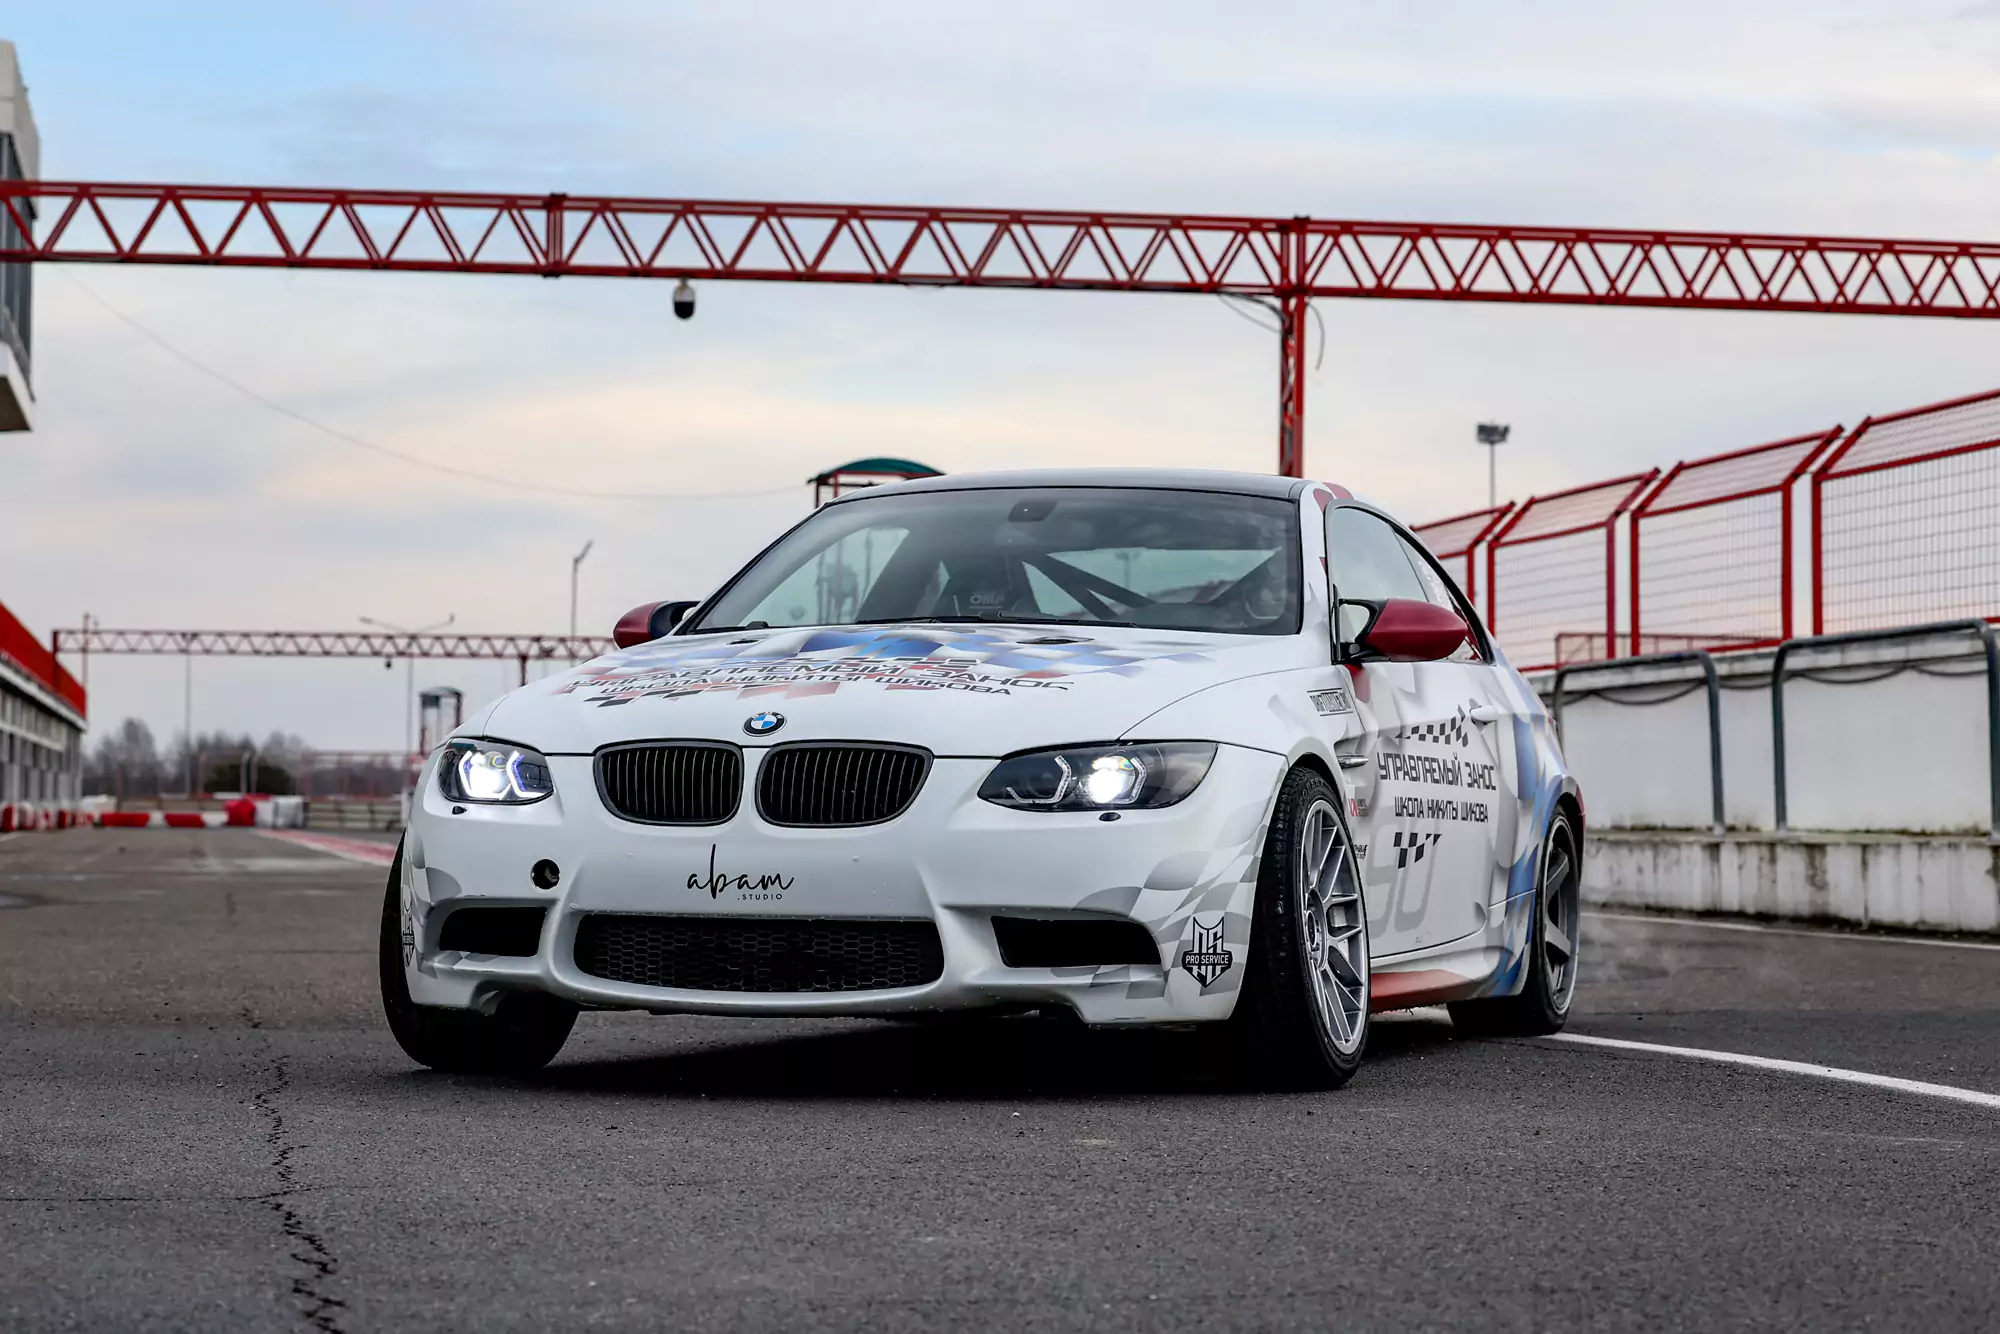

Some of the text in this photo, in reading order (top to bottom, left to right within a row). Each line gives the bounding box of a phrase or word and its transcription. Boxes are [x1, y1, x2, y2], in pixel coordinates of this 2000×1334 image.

[600, 677, 710, 694] ШКОЛА
[874, 676, 1012, 696] ШИКОВА
[919, 669, 1075, 691] ЗАНОС
[1377, 752, 1497, 791] УПРАВЛЯЕМЫЙ ЗАНОС
[1394, 796, 1425, 818] ШКОЛА
[1427, 798, 1459, 820] НИКИТЫ
[1461, 801, 1489, 823] ШИКОВА
[1185, 954, 1229, 965] PRO SERVICE
